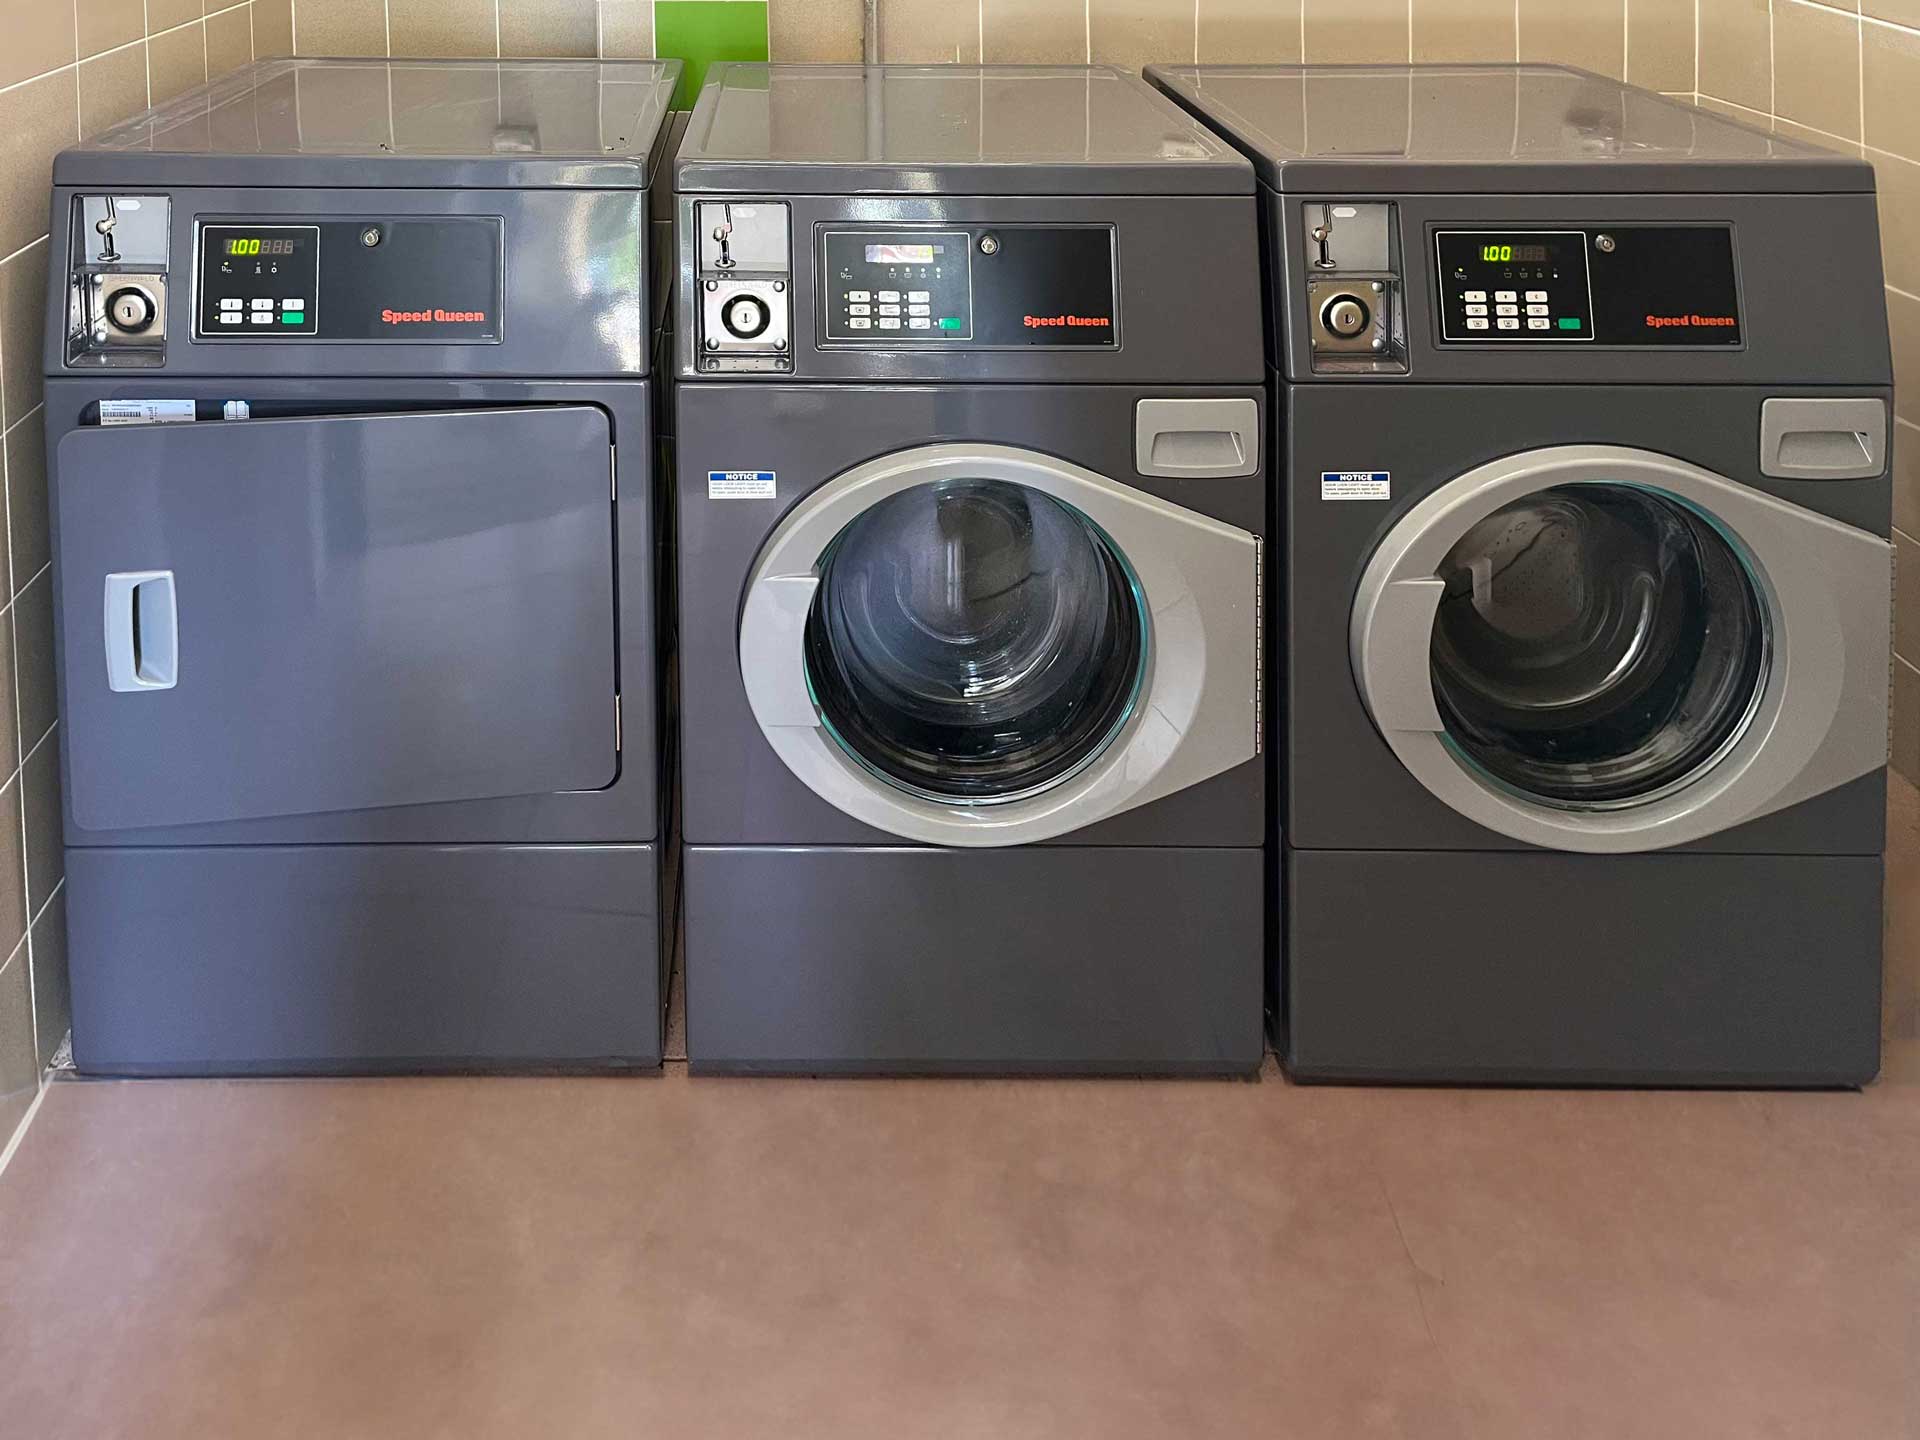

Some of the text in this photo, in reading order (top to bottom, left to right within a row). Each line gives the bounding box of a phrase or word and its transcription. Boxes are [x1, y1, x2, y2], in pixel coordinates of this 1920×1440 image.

[382, 309, 485, 325] Speed Queen
[1023, 315, 1109, 329] Speed Queen
[1646, 315, 1735, 329] Speed Queen
[725, 473, 759, 481] NOTICE
[1340, 474, 1373, 482] NOTICE
